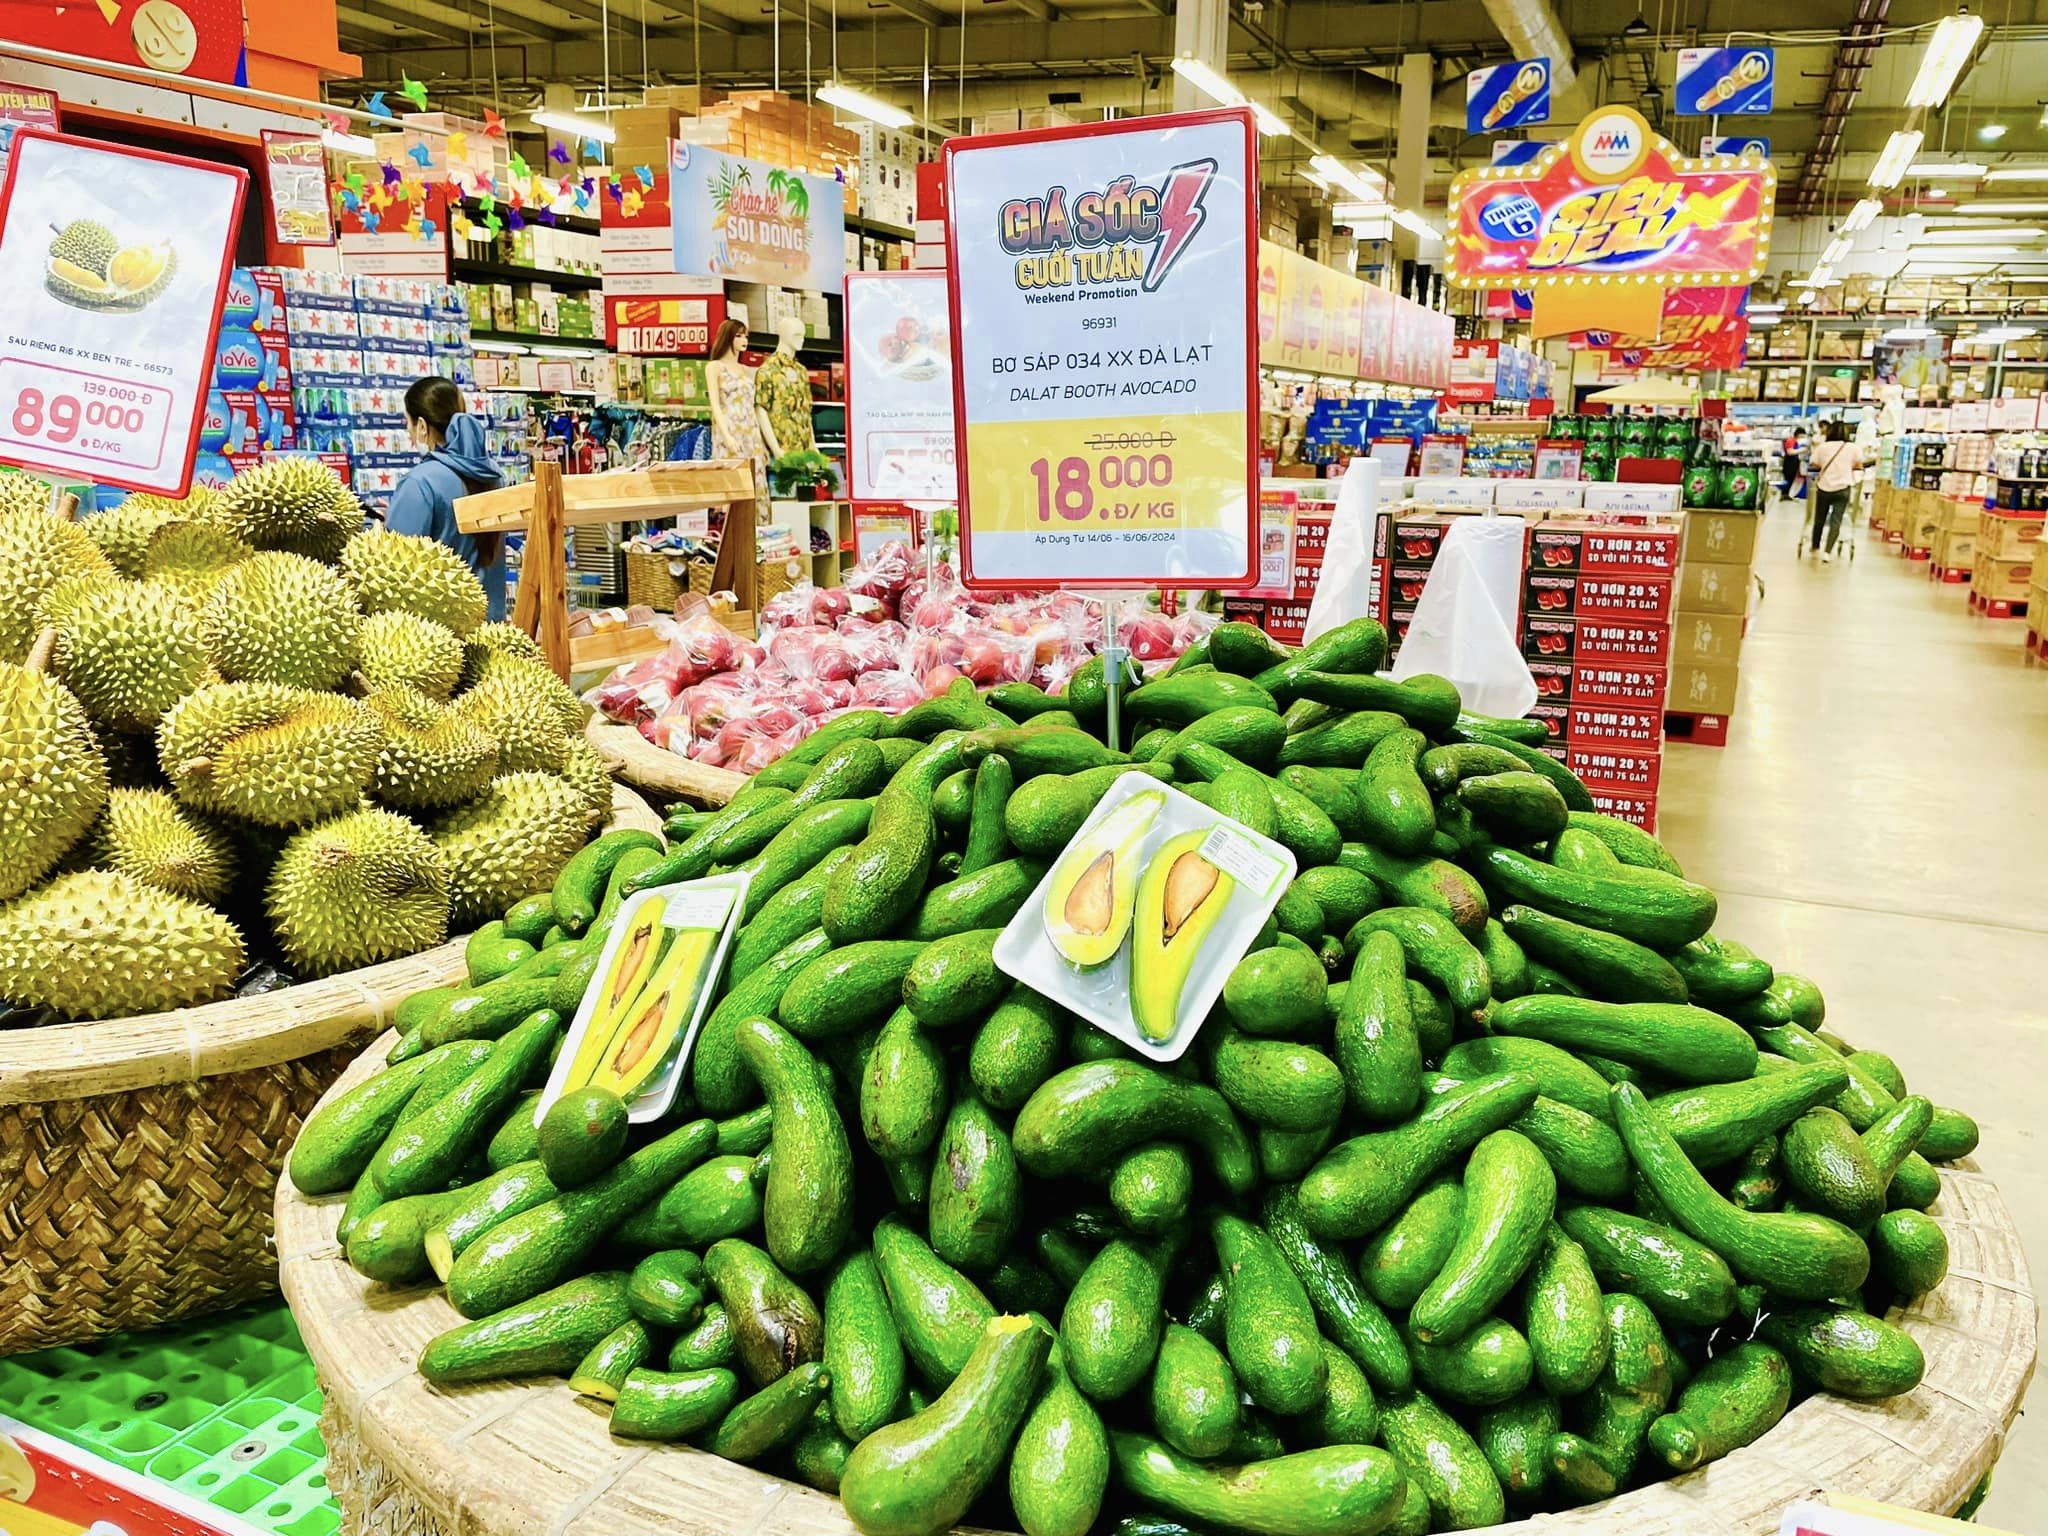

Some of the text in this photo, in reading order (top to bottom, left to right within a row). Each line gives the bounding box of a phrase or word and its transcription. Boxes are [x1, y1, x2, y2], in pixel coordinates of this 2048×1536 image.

[1551, 176, 1684, 233] SIÊU
[1001, 177, 1160, 253] GIÁ SỐC
[726, 213, 755, 243] SÔI
[1509, 214, 1535, 238] 6
[1025, 287, 1138, 304] Weekend Promotion
[1082, 317, 1117, 330] 96931
[77, 349, 90, 359] XX
[115, 357, 131, 367] TRE
[143, 363, 174, 375] 66573
[992, 357, 1017, 373] BƠ
[1066, 352, 1101, 369] 034
[1107, 350, 1134, 367] XX
[1139, 344, 1168, 365] ĐÀ
[1174, 345, 1213, 366] LẠT
[1010, 379, 1197, 402] DALAT BOOTH AVOCADO
[1148, 502, 1175, 519] KG
[1311, 526, 1325, 536] 20
[1589, 539, 1603, 550] TO
[1635, 541, 1650, 552] 20
[1655, 542, 1666, 552] %
[1632, 555, 1642, 563] 75
[1583, 583, 1597, 594] TO
[1629, 585, 1644, 596] 20
[1648, 586, 1659, 597] %
[1581, 597, 1592, 606] SO
[1626, 599, 1636, 608] 75
[1639, 601, 1657, 609] GAM
[1271, 606, 1284, 617] TO
[1369, 605, 1379, 618] 20
[1271, 619, 1280, 627] SO
[1583, 627, 1597, 638] TO
[1628, 629, 1643, 641] 20
[1648, 630, 1658, 642] %
[1581, 641, 1592, 649] SO
[1625, 643, 1635, 652] 75
[1639, 645, 1657, 653] GAM
[1580, 670, 1594, 681] TO
[1625, 673, 1639, 684] 20
[1644, 674, 1655, 685] %
[1578, 684, 1589, 693] SO
[1622, 686, 1632, 695] 75
[1635, 688, 1653, 697] GAM
[1576, 712, 1590, 723] TO
[1621, 715, 1635, 726] 20
[1640, 716, 1650, 727] %
[1574, 726, 1585, 734] SO
[1618, 728, 1628, 737] 75
[1631, 730, 1649, 739] GAM
[1574, 754, 1588, 765] TO
[1619, 758, 1634, 769] 20
[1638, 759, 1649, 770] %
[1616, 771, 1626, 780] 75
[1629, 772, 1647, 782] GAM
[1616, 799, 1631, 810] 20
[1635, 800, 1646, 812] %
